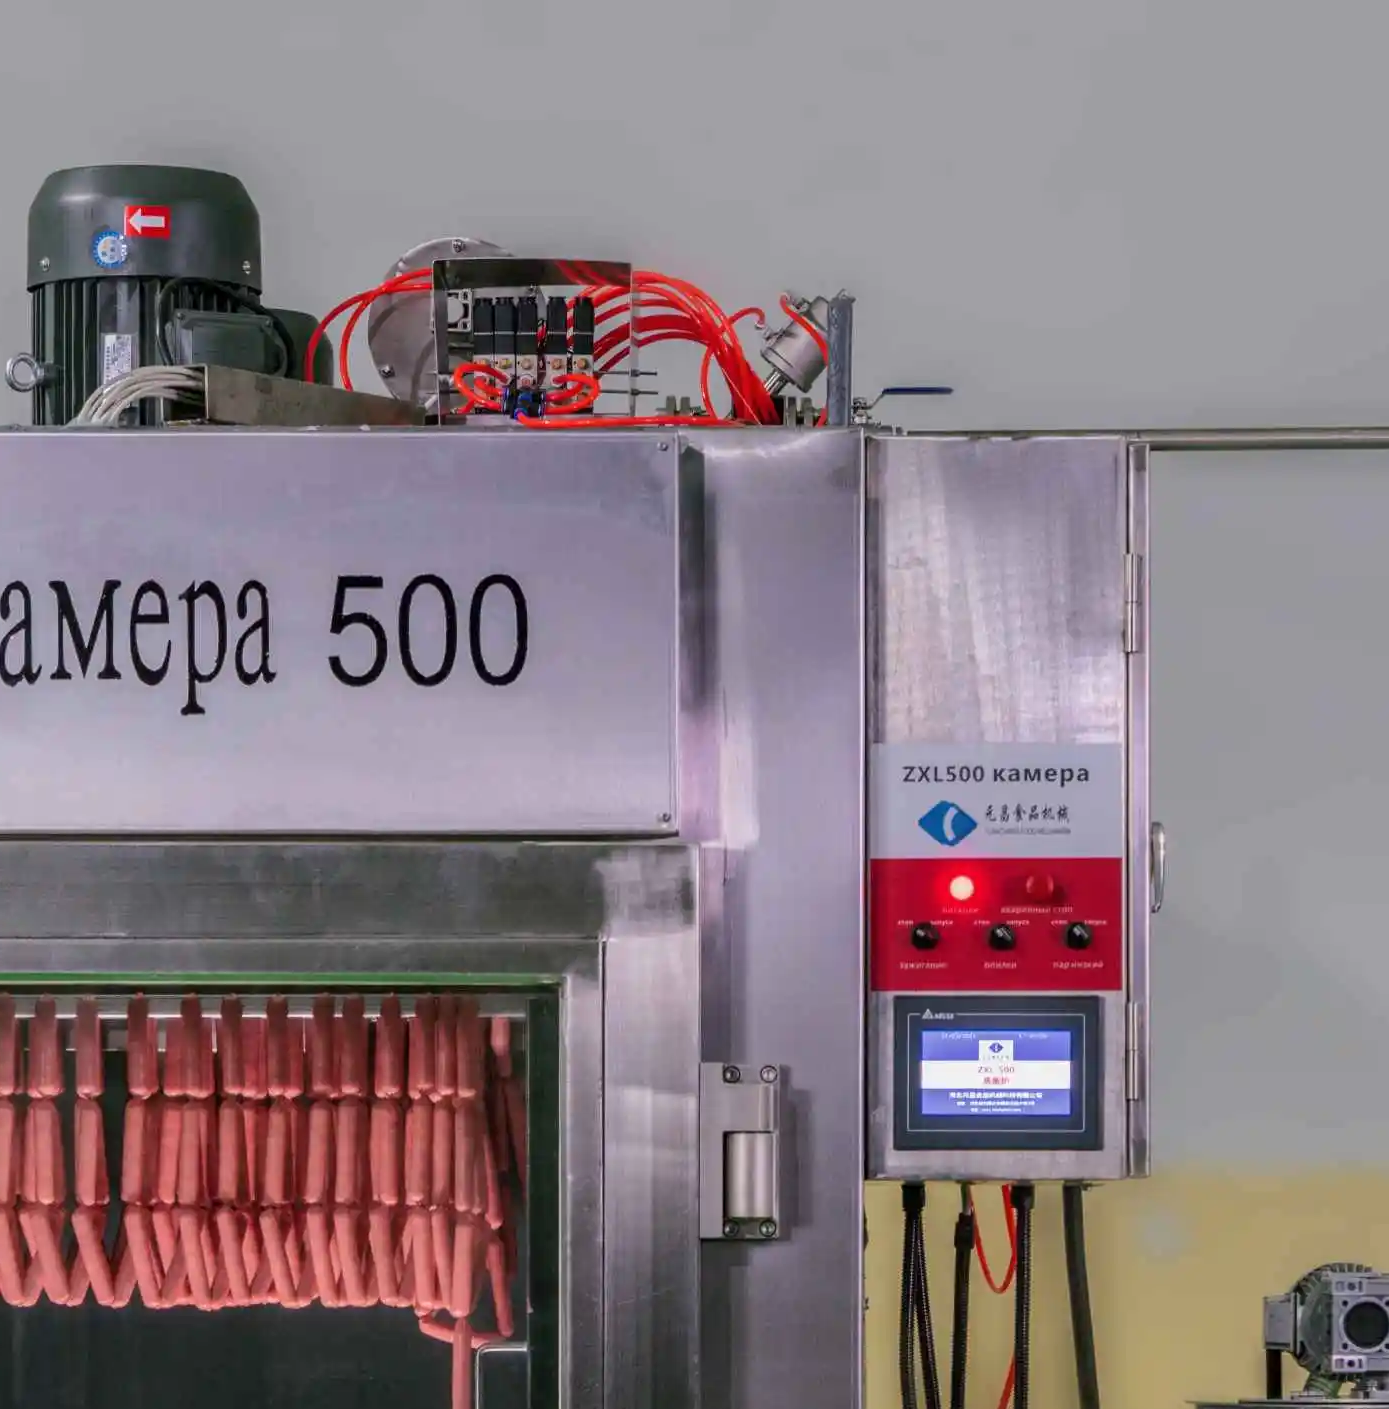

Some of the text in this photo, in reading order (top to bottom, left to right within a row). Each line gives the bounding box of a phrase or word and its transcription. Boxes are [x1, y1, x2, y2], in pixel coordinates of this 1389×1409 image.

[327, 573, 529, 687] 500
[902, 765, 1090, 788] ZXL500 камера
